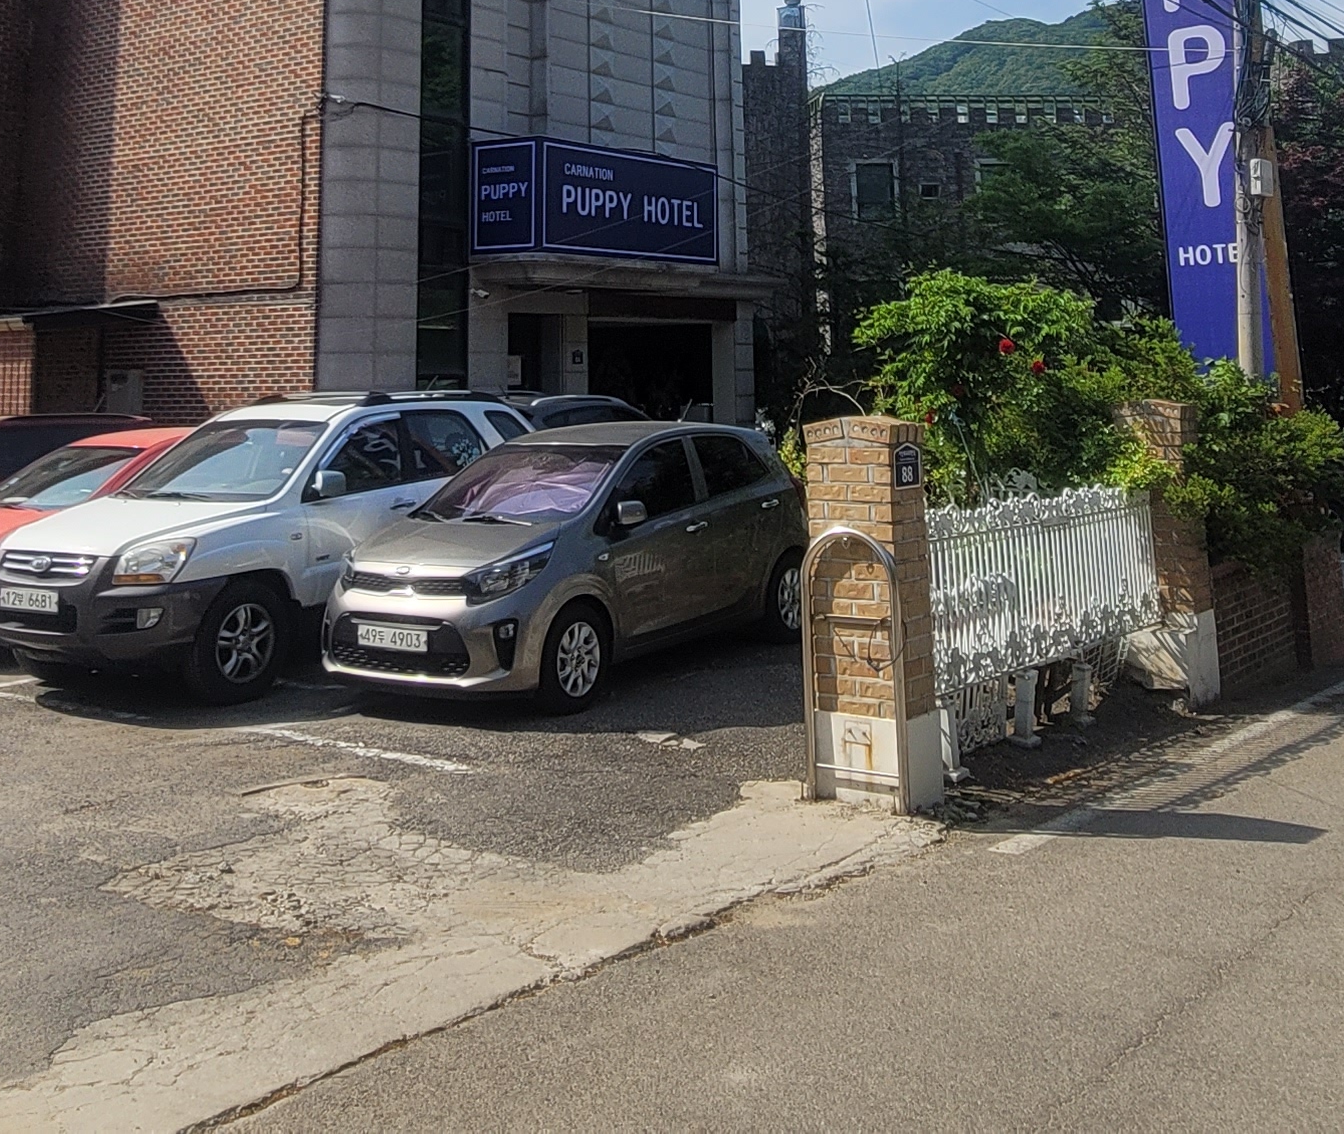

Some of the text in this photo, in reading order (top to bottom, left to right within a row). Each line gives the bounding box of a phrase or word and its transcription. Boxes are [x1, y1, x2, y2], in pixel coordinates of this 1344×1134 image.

[563, 162, 614, 182] CARNATION
[481, 181, 529, 202] PUPPY
[481, 209, 513, 223] HOTEL
[561, 184, 704, 229] PUPPY HOTEL
[1178, 243, 1239, 266] HOTE
[902, 465, 913, 483] 88
[28, 593, 52, 609] 6681
[362, 628, 421, 649] 49두 4903
